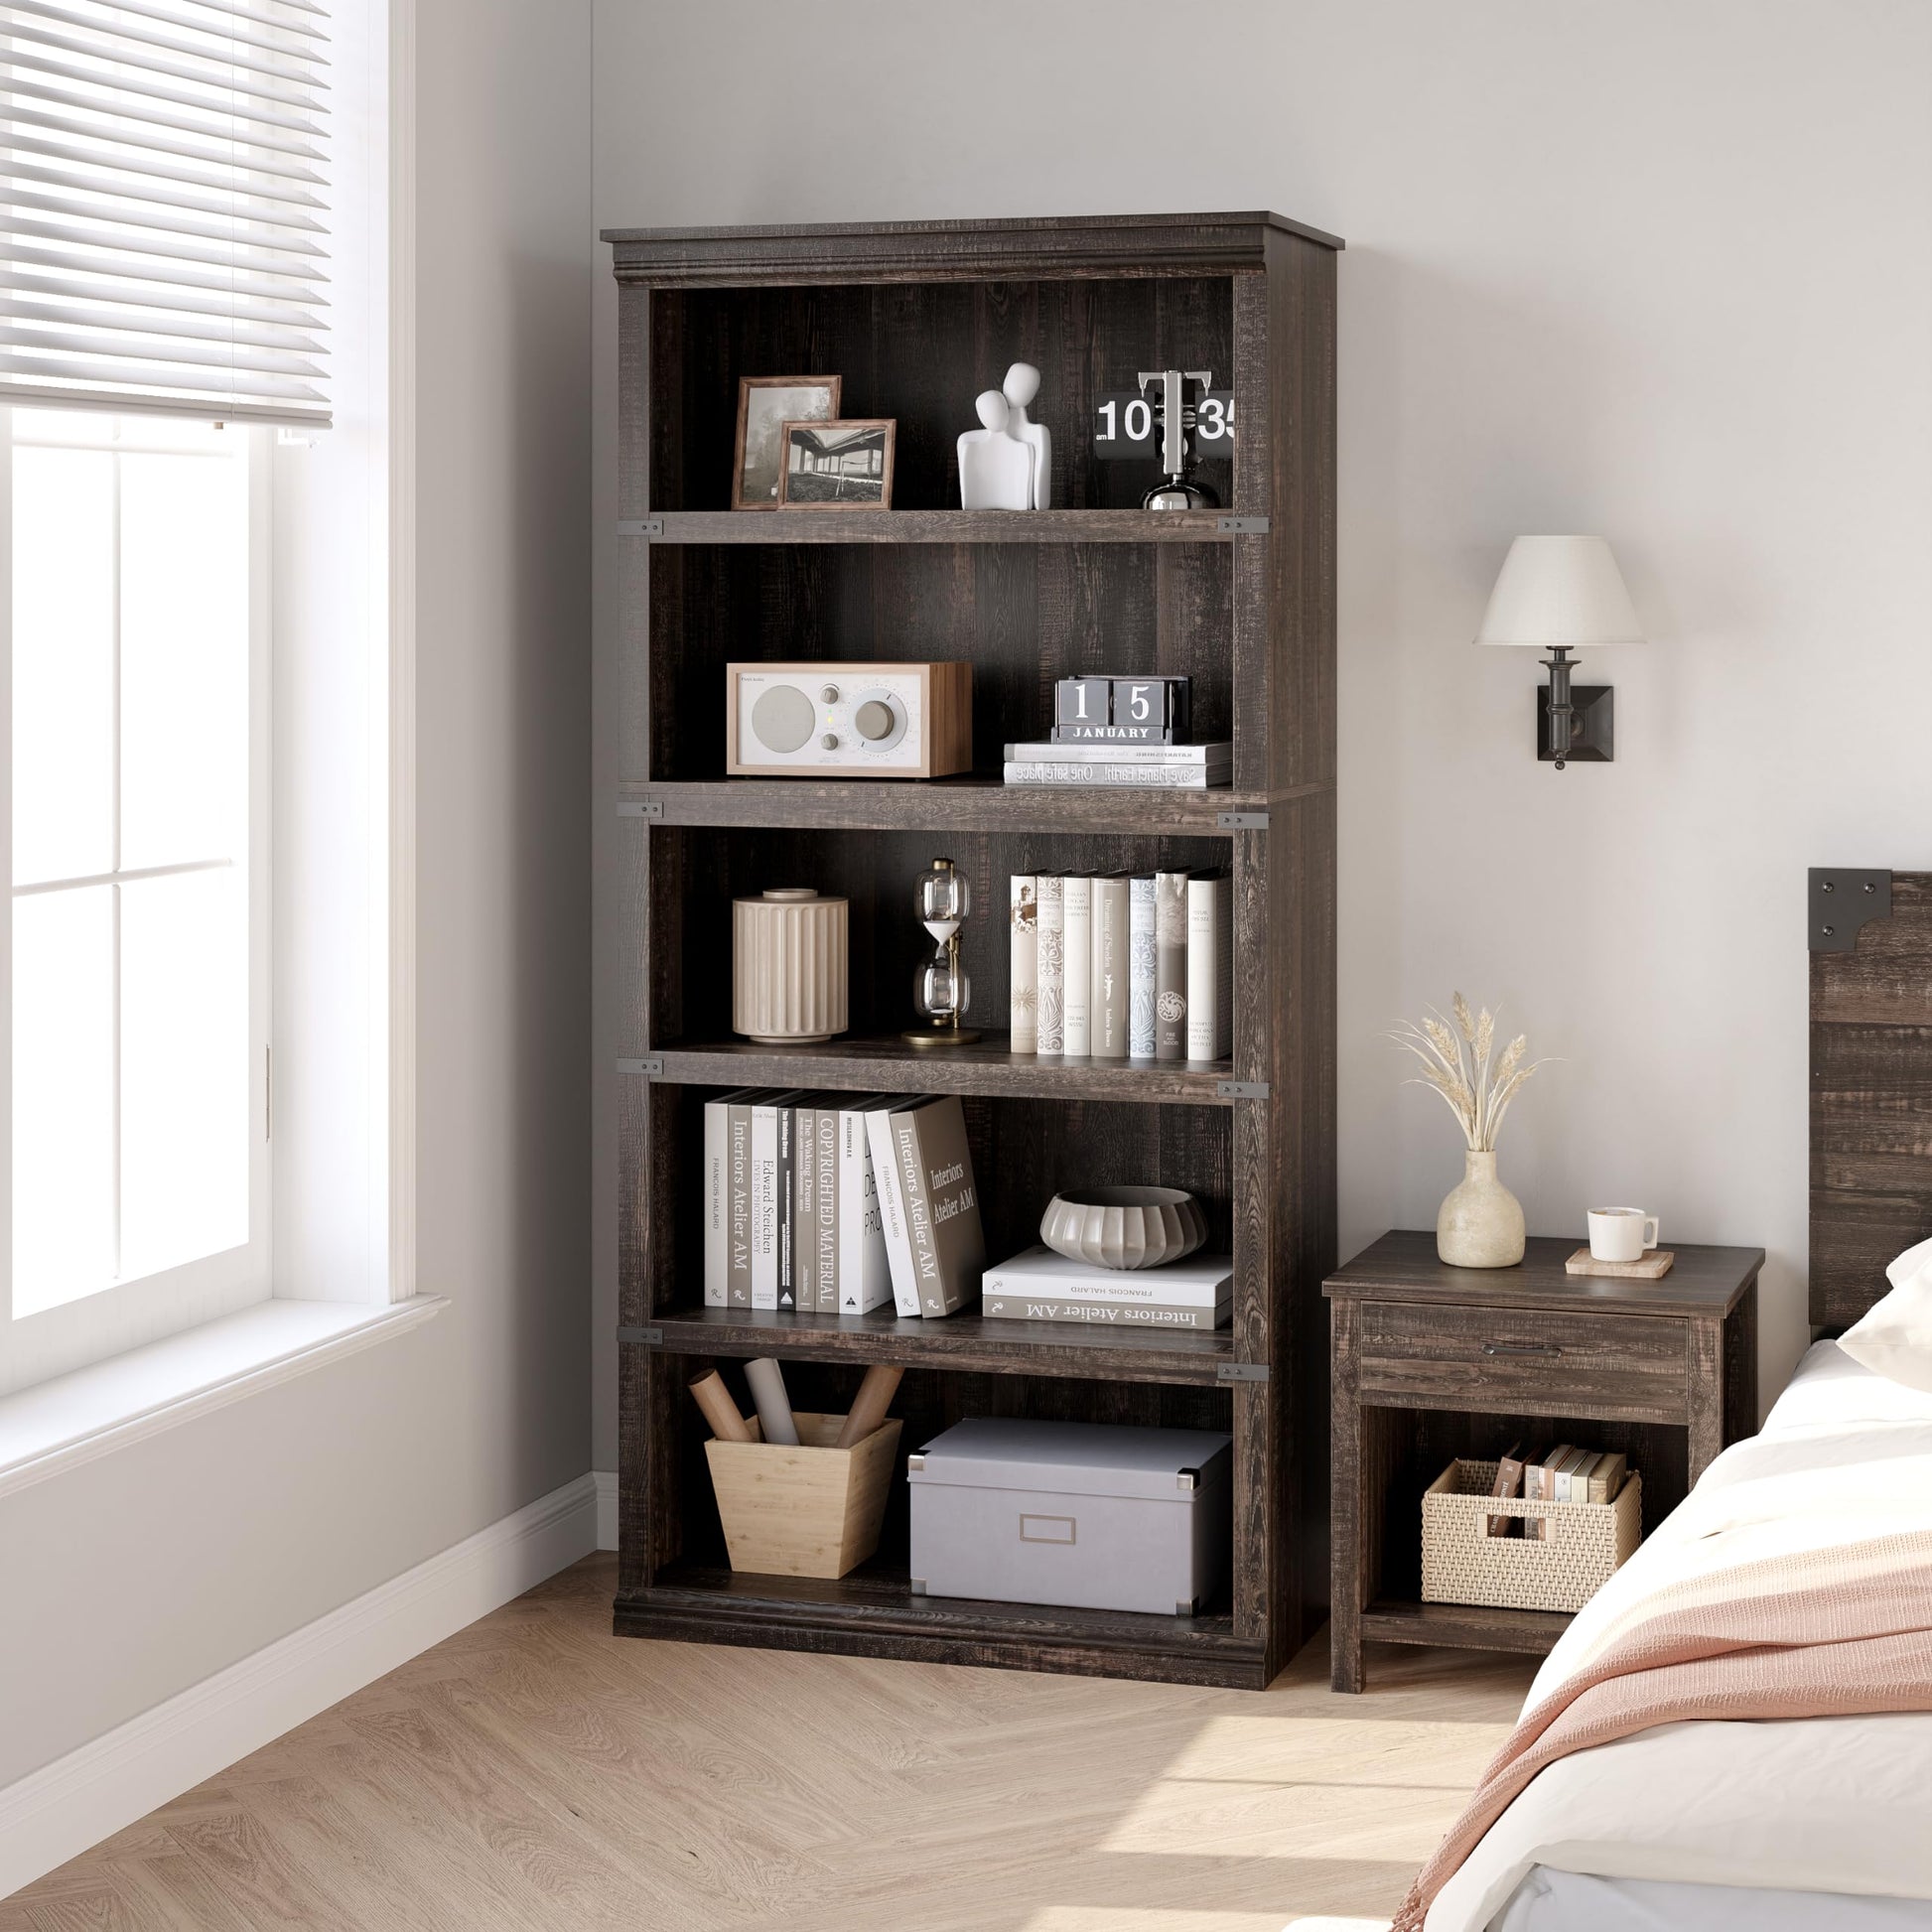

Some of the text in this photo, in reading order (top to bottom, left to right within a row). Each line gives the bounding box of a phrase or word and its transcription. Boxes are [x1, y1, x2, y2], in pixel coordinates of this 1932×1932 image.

[1098, 399, 1151, 441] 10
[1075, 683, 1088, 719] 1
[1131, 686, 1150, 721] 5
[1073, 727, 1150, 739] JANUARY
[1103, 898, 1113, 932] Dreaming
[1104, 941, 1113, 968] Sweden
[803, 1117, 813, 1212] The Waking Dream
[929, 1162, 964, 1190] Interiors
[734, 1120, 748, 1270] Interiors Atelier AM
[753, 1183, 760, 1193] IN
[882, 1166, 899, 1238] FRANCOIS HALARD
[898, 1128, 936, 1280] Interiors Atelier AM
[933, 1187, 975, 1224] Atelier AM
[762, 1160, 773, 1254] Edward Steichen
[820, 1118, 834, 1304] COPYRIGHTED MATERIAL
[1070, 1286, 1153, 1298] FRANCOIS HALARD
[1026, 1304, 1197, 1326] Interiors Atelier AM
